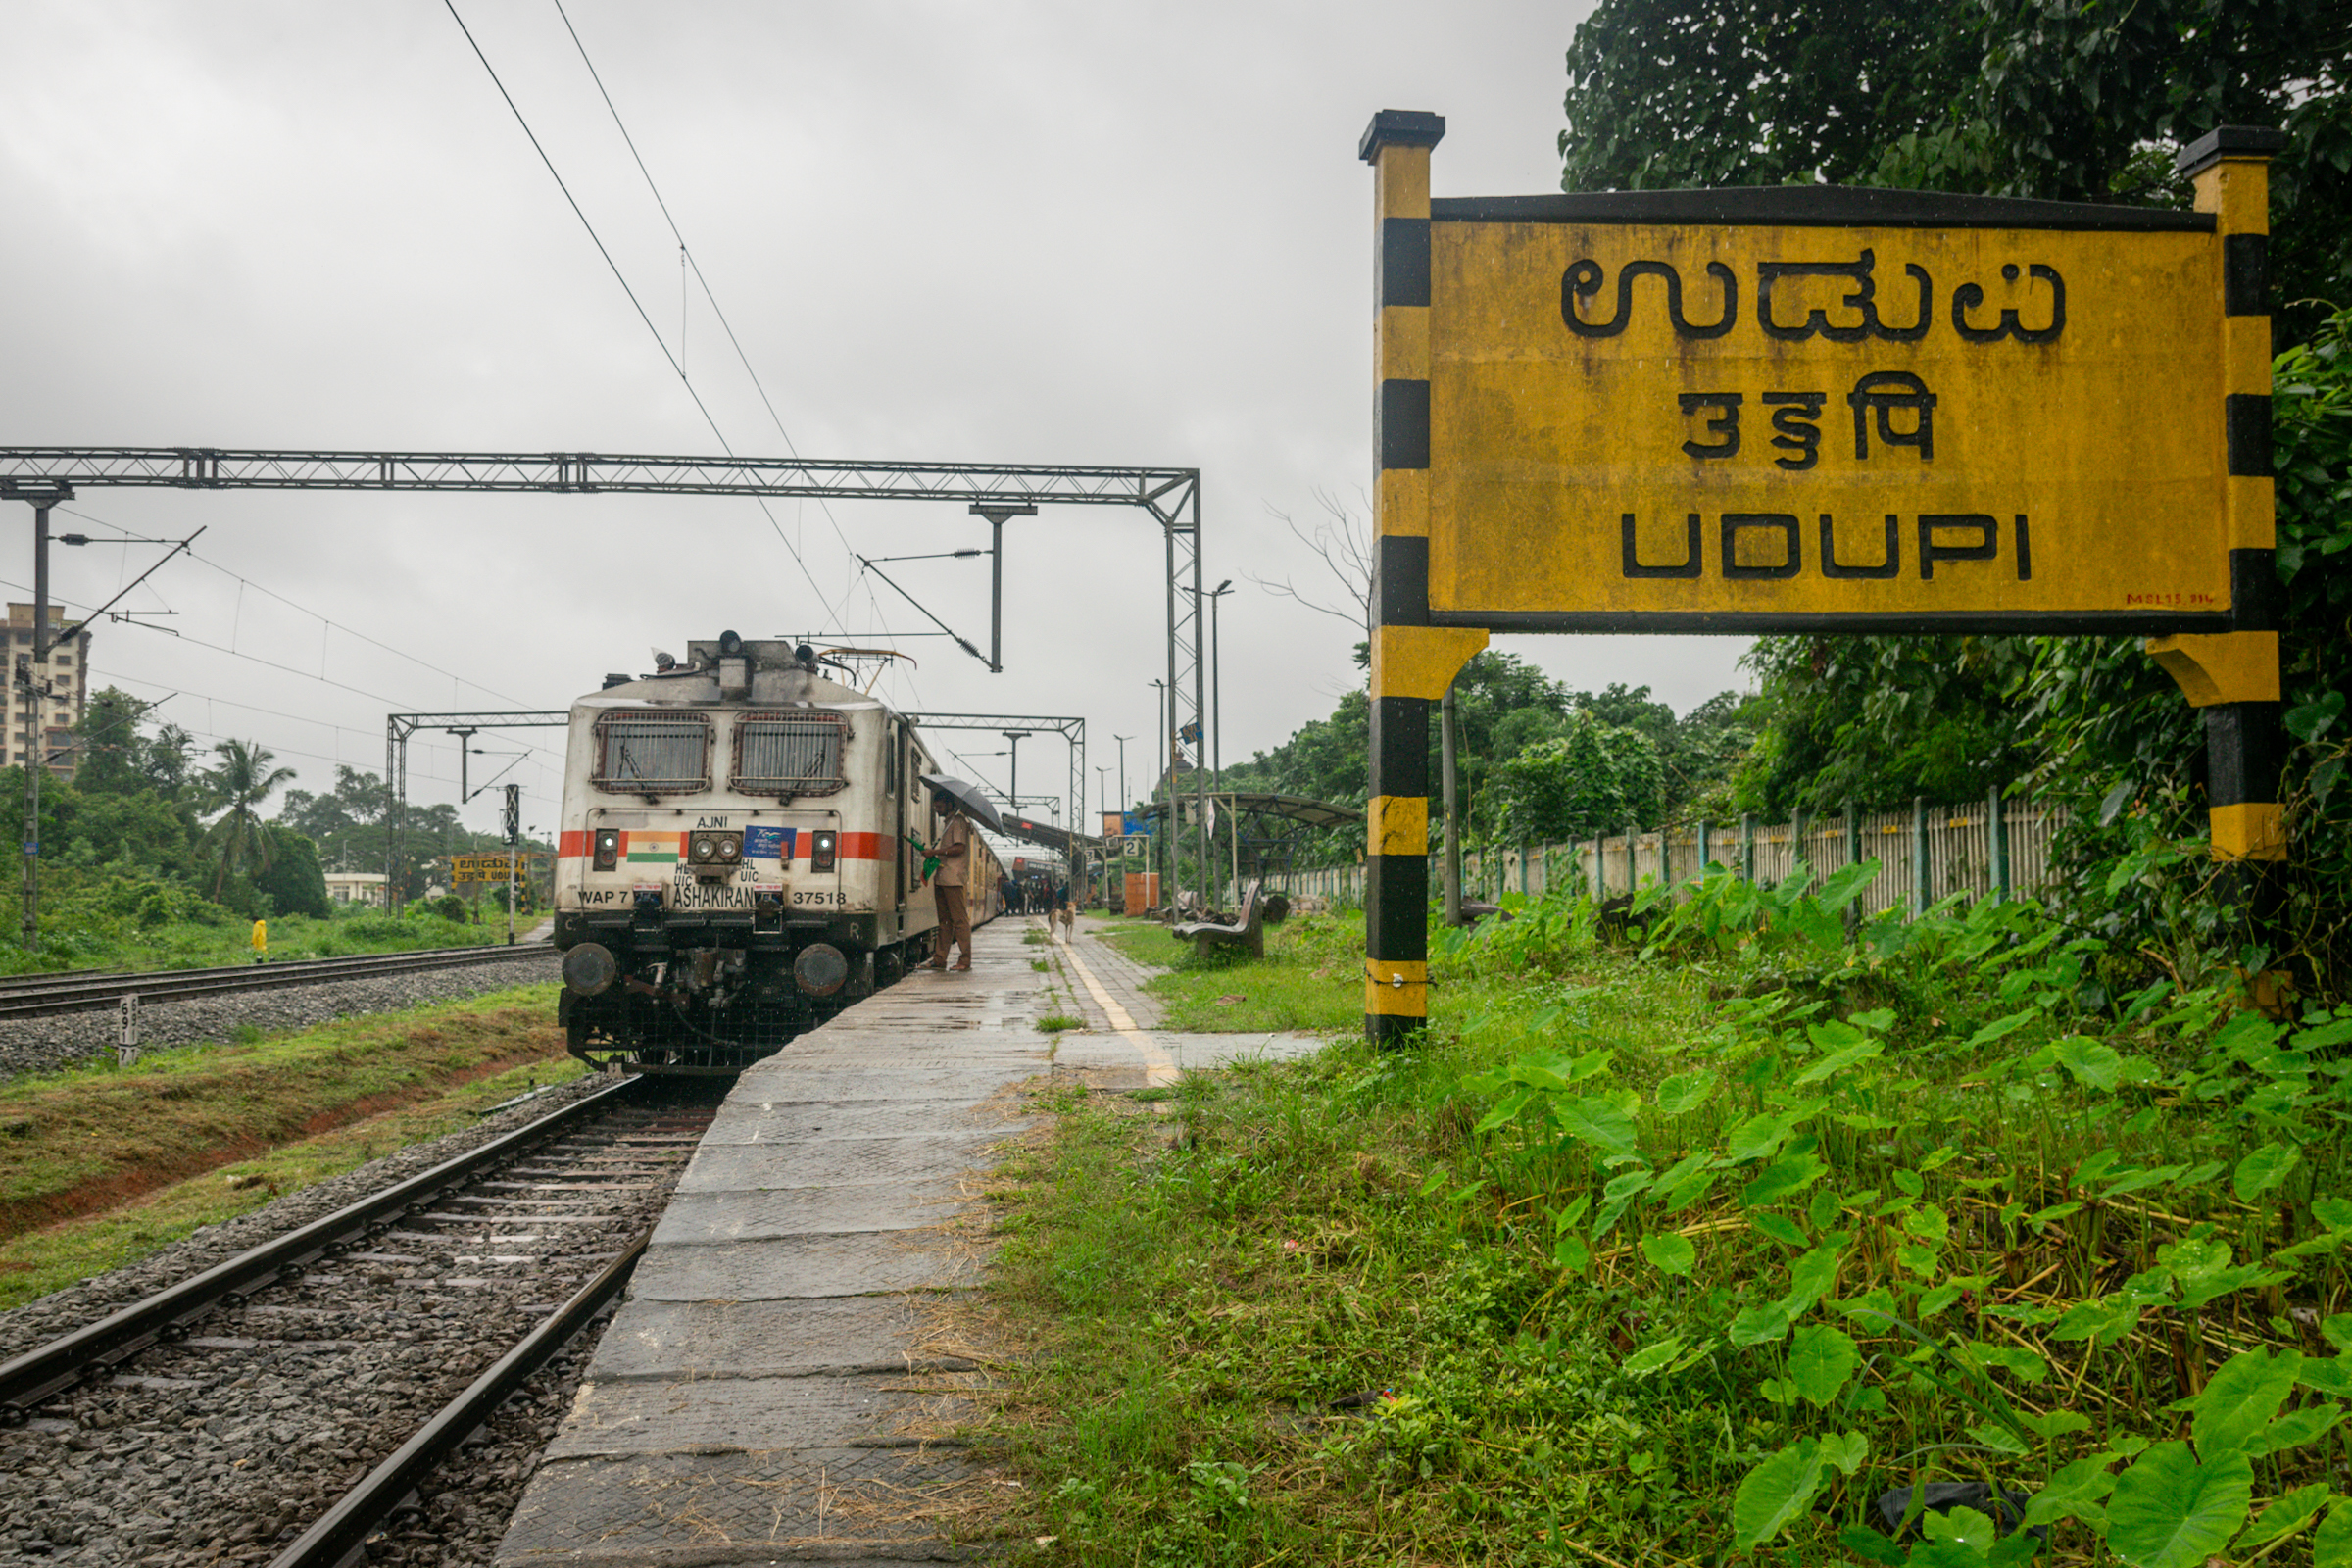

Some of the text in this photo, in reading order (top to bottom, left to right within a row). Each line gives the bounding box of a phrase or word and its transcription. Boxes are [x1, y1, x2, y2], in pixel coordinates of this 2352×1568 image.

[1562, 247, 2067, 343] ಉಡುಪಿ
[1678, 370, 1937, 471] उडुपि
[1621, 513, 2032, 581] UDUPI
[697, 816, 728, 828] AJNI
[1126, 841, 1135, 855] 2
[675, 863, 689, 874] HL
[742, 858, 756, 870] HL
[674, 875, 693, 887] UIC
[740, 871, 759, 882] UIC
[578, 891, 628, 904] WAP 7
[673, 886, 754, 907] ASHAKIRAN
[793, 892, 847, 905] 37518
[121, 1048, 127, 1061] 7
